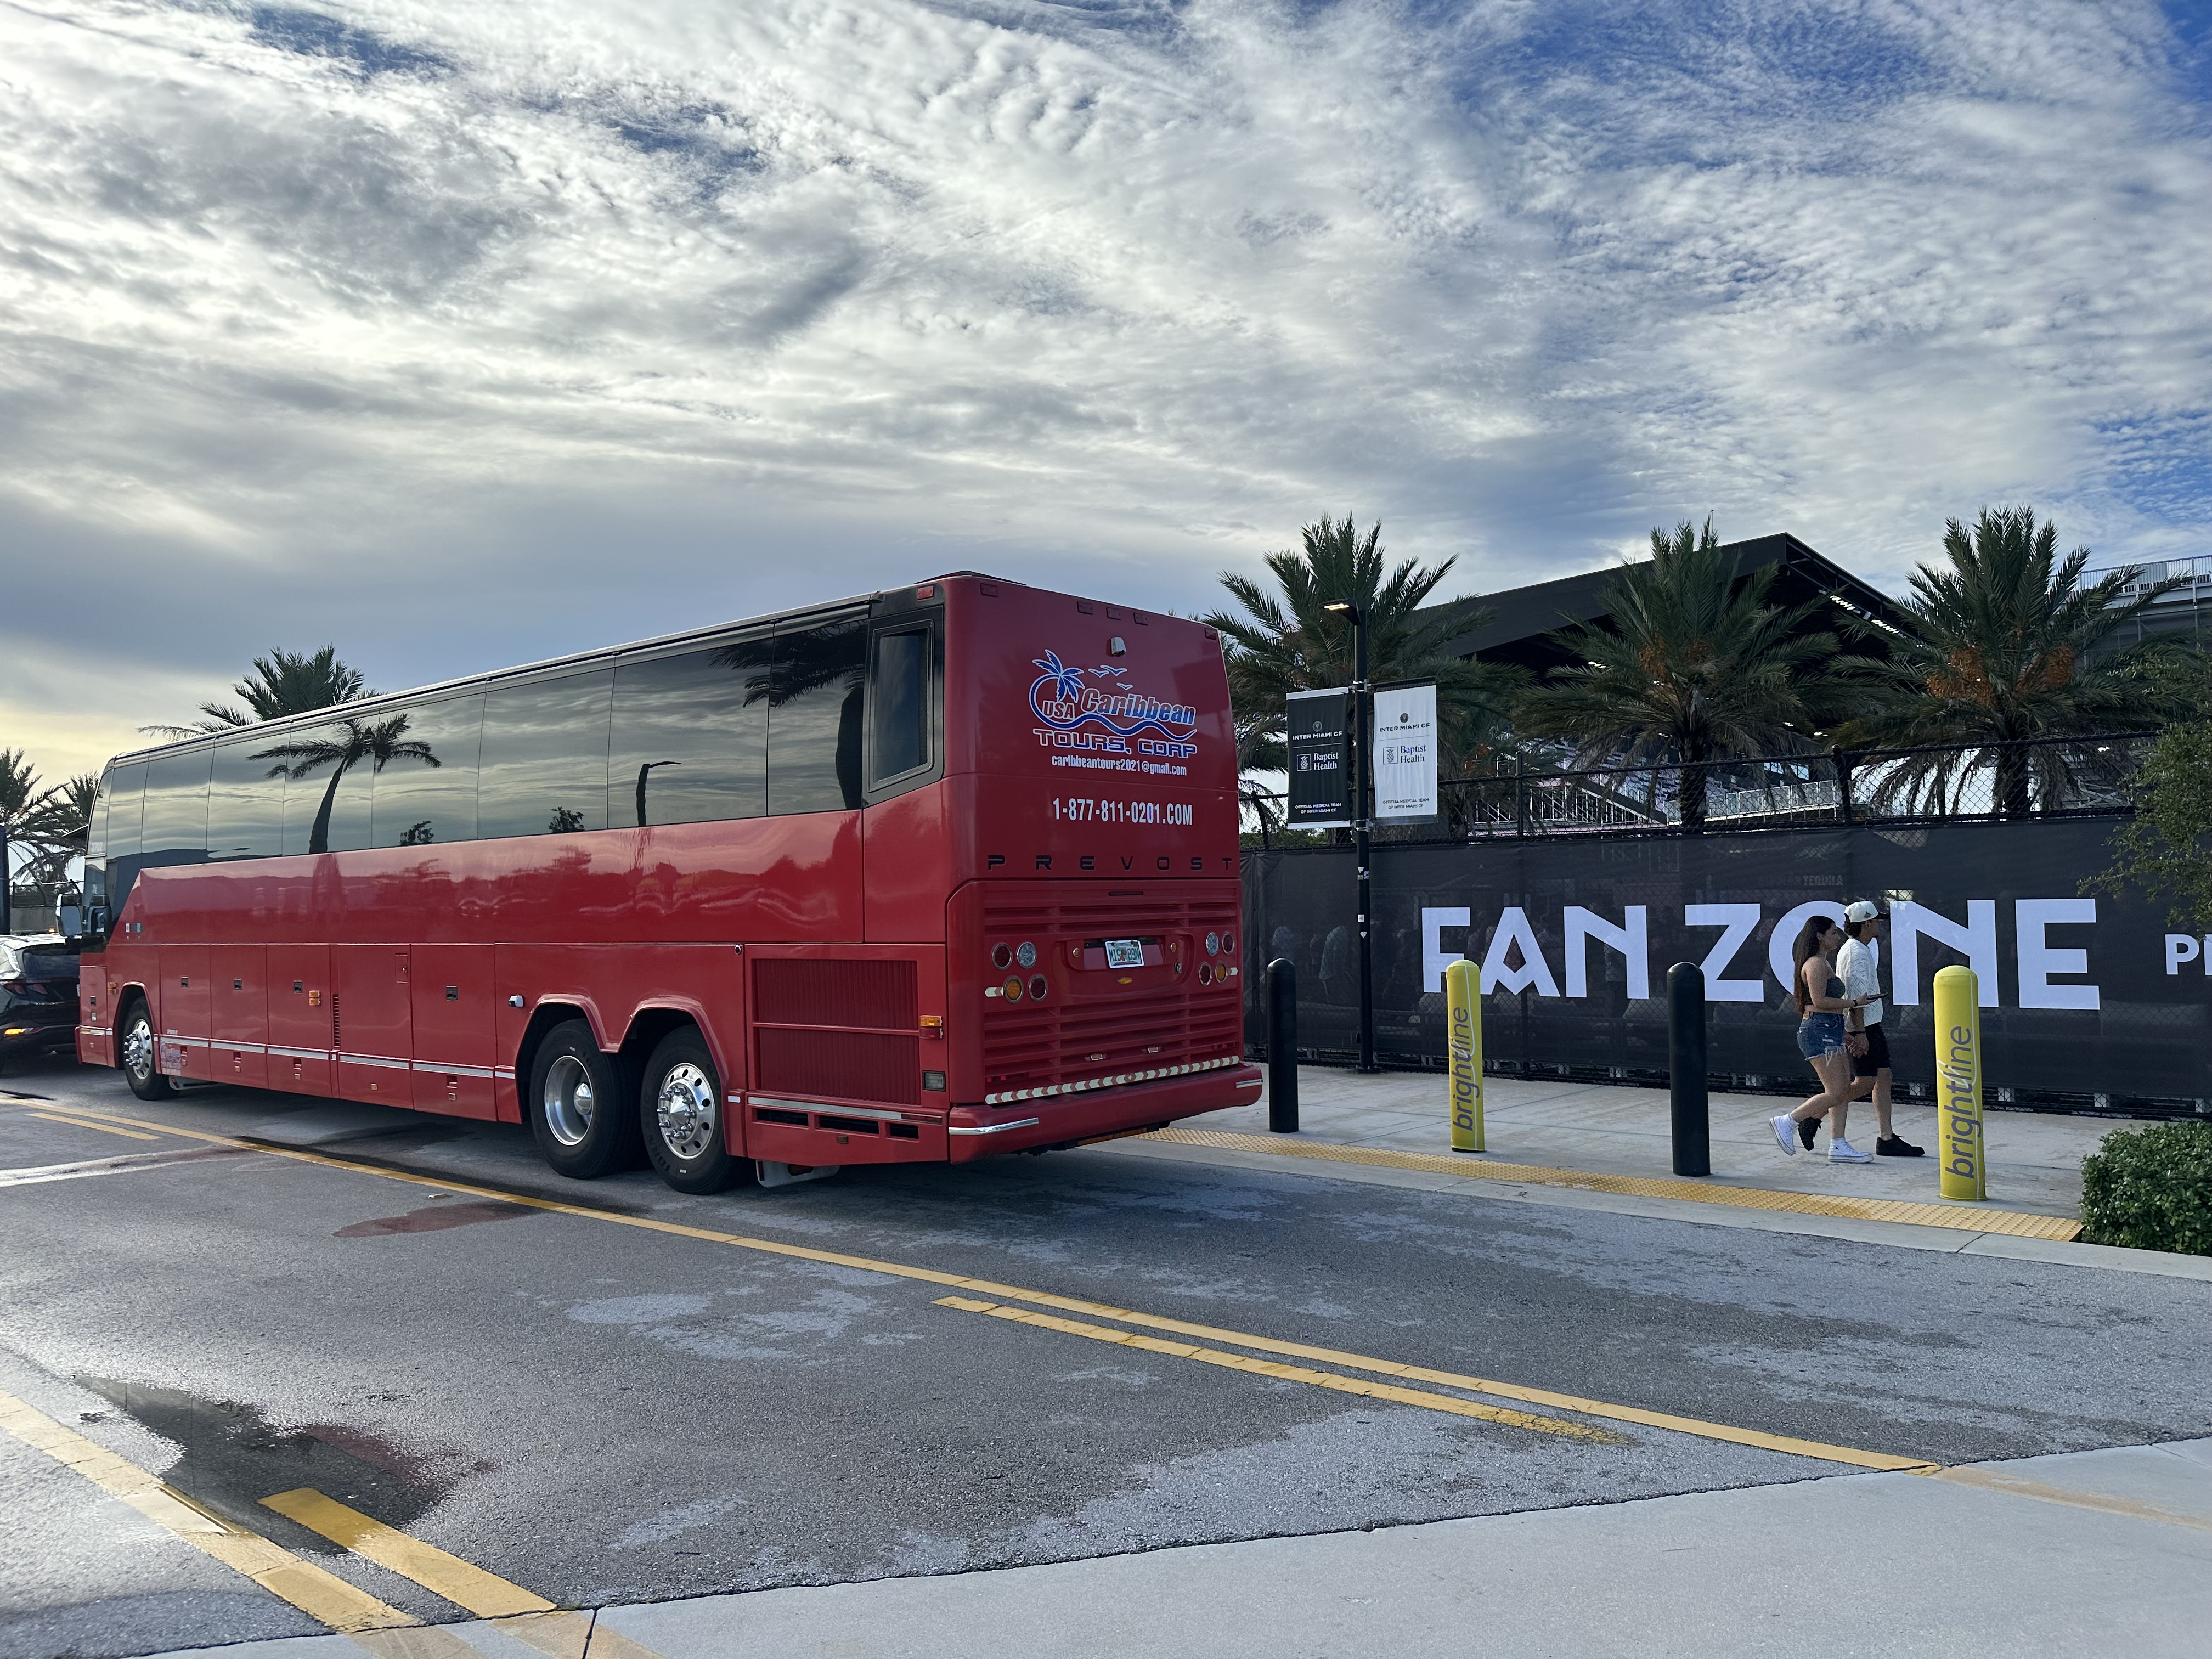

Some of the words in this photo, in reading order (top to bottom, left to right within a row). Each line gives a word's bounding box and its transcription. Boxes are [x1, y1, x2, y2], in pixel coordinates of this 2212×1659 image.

[1042, 700, 1075, 720] USA
[1081, 688, 1197, 725] Caribbean
[1033, 729, 1132, 754] TOURS,
[1138, 738, 1198, 758] CORP
[1401, 744, 1426, 755] Baptist
[1051, 755, 1187, 776] caribbeantours2021@gmail.com
[1313, 751, 1339, 762] Baptist
[1313, 761, 1337, 770] Health
[1401, 754, 1425, 764] Health
[1053, 798, 1193, 825] 1-877-811-0201.COM
[988, 854, 1232, 871] PREVOST
[1803, 875, 1843, 885] TEQUILA
[1421, 905, 1649, 1000] FAN
[1685, 899, 2100, 1011] ZONE
[2165, 934, 2212, 975] P
[1451, 1007, 1480, 1131] brightline
[1944, 1026, 1980, 1179] brightline
